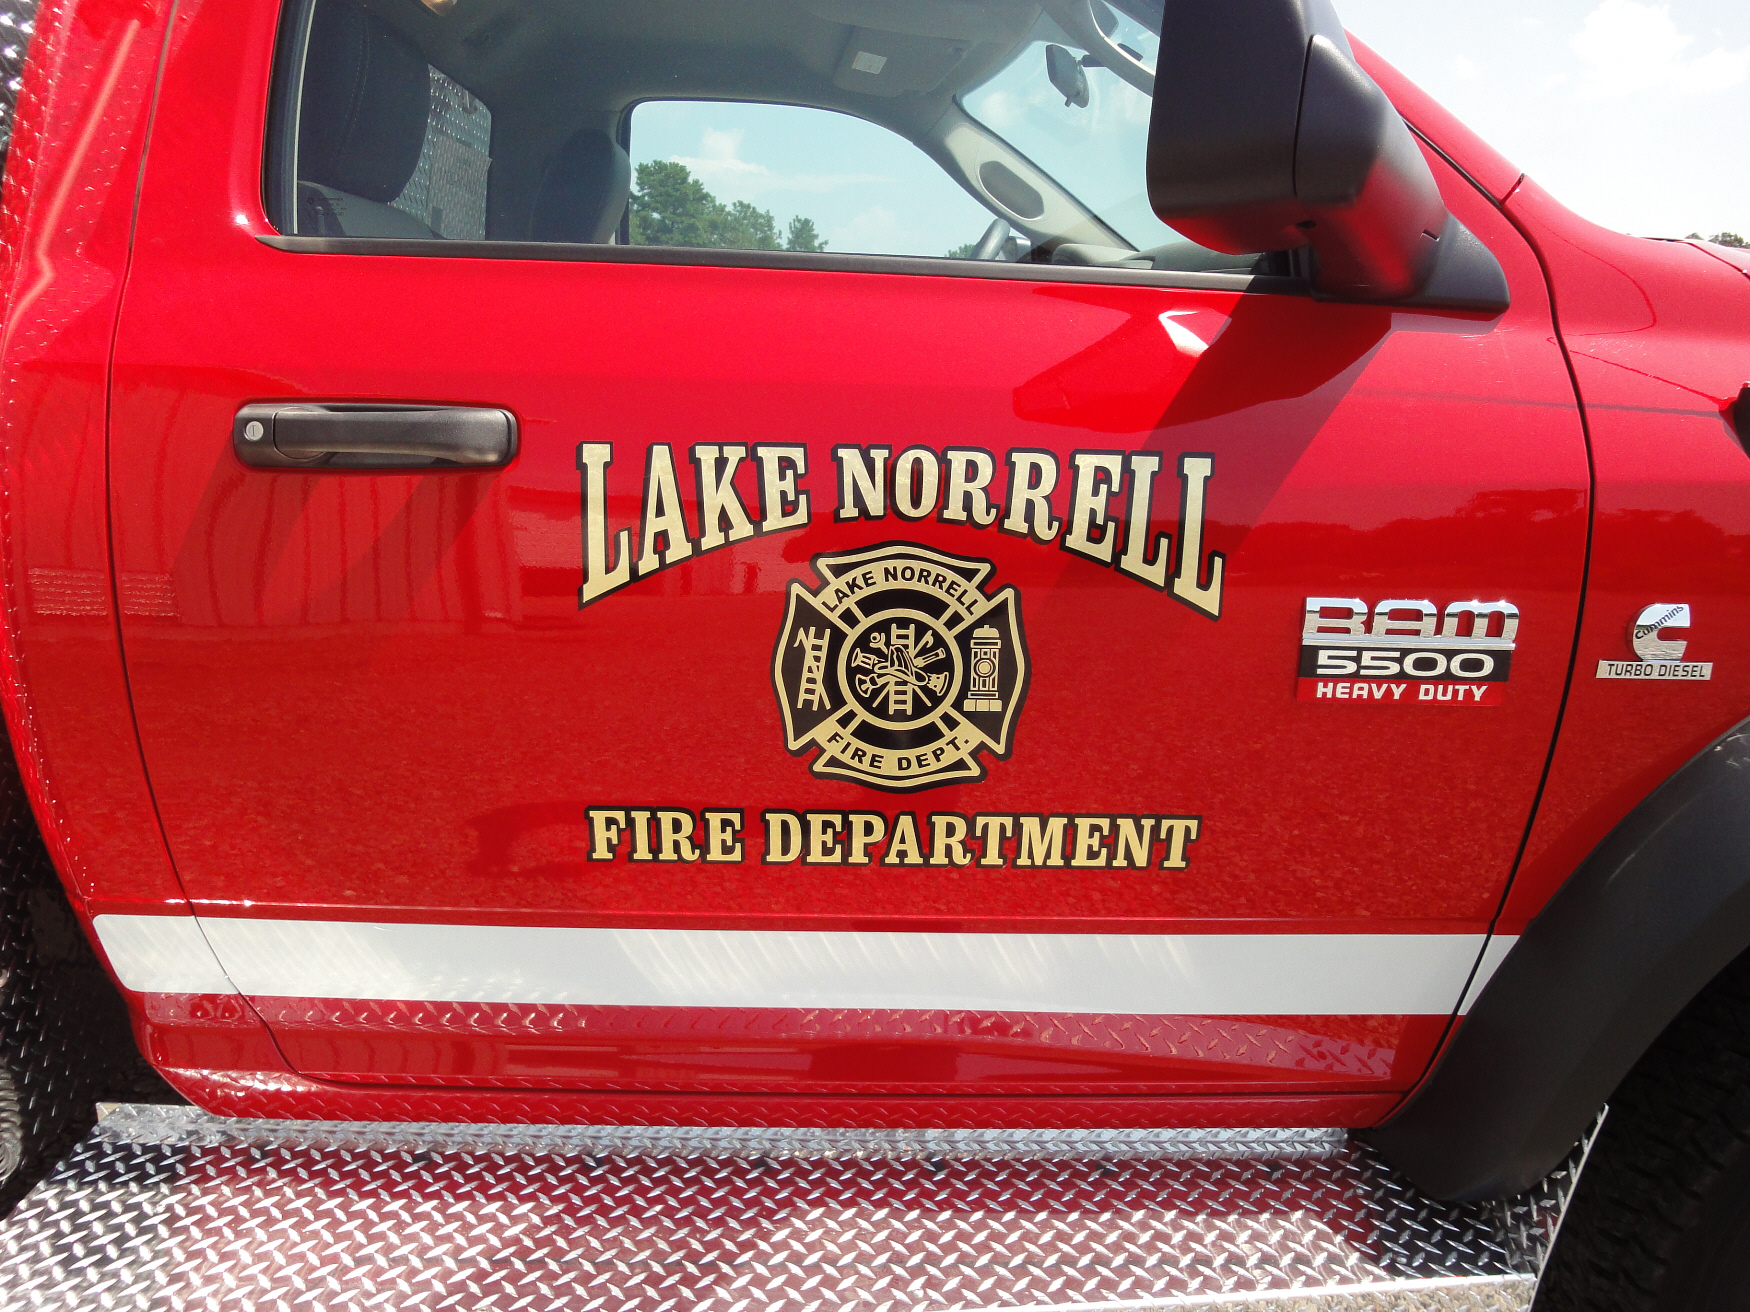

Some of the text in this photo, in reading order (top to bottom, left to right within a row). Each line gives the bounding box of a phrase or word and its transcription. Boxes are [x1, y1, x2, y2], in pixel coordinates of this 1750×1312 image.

[578, 441, 1225, 620] LAKE NORRELL
[821, 566, 980, 615] LAKE NORRELL
[1316, 651, 1495, 678] 5500
[1607, 663, 1706, 678] TURBO DIESEL
[1316, 681, 1489, 702] HEAVY DUTY
[826, 731, 971, 772] FIRE DEPT.
[586, 807, 1202, 871] FIRE DEPARTMENT
